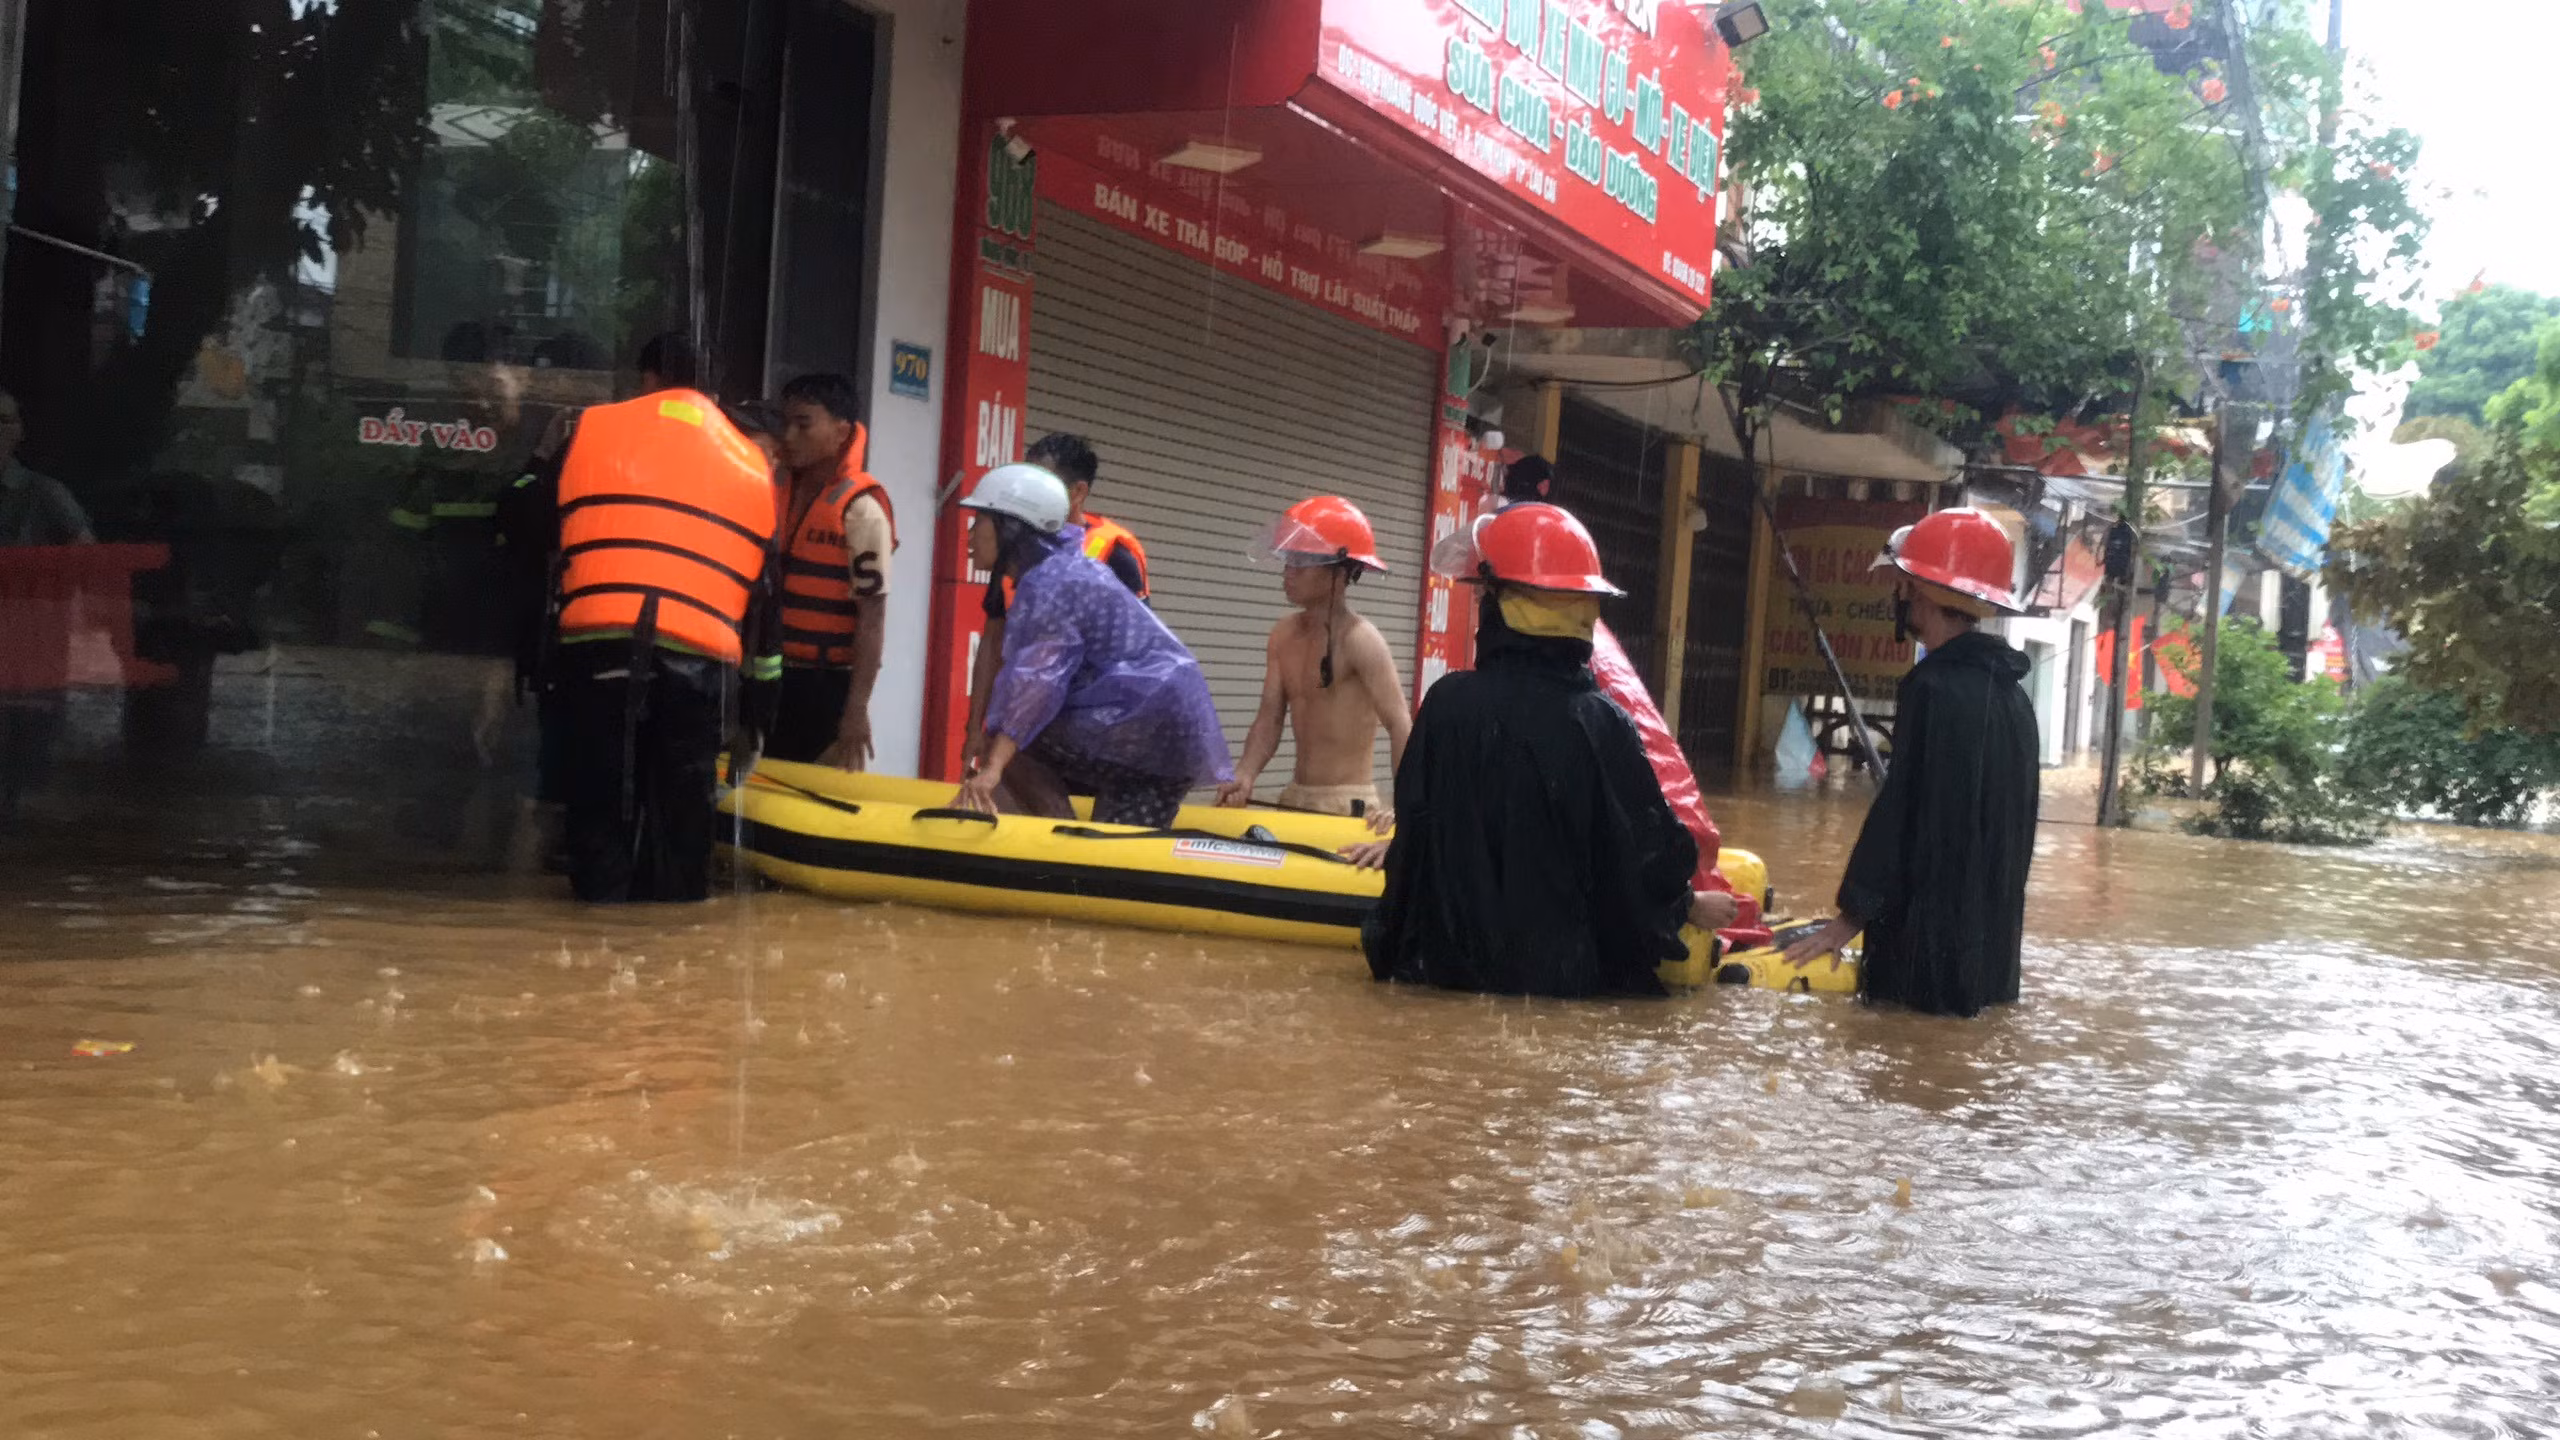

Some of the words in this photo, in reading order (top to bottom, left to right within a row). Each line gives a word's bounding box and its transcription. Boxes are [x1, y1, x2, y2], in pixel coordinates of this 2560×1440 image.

[1446, 29, 1493, 116] SỬA
[1499, 74, 1552, 155] CHỮA
[1564, 112, 1602, 186] BẢO
[1602, 146, 1659, 225] DƯỠNG
[1667, 101, 1690, 175] XE
[1095, 184, 1138, 222] BÁN
[1144, 204, 1170, 237] XE
[1175, 215, 1211, 251] TRẢ
[1214, 234, 1249, 265] GÓP
[1290, 266, 1320, 300] TRỢ
[979, 286, 1019, 361] MUA
[896, 351, 927, 380] 970
[359, 407, 427, 447] ĐẨY
[430, 418, 497, 453] VÀO
[976, 391, 1016, 469] BÁN
[853, 551, 883, 597] S
